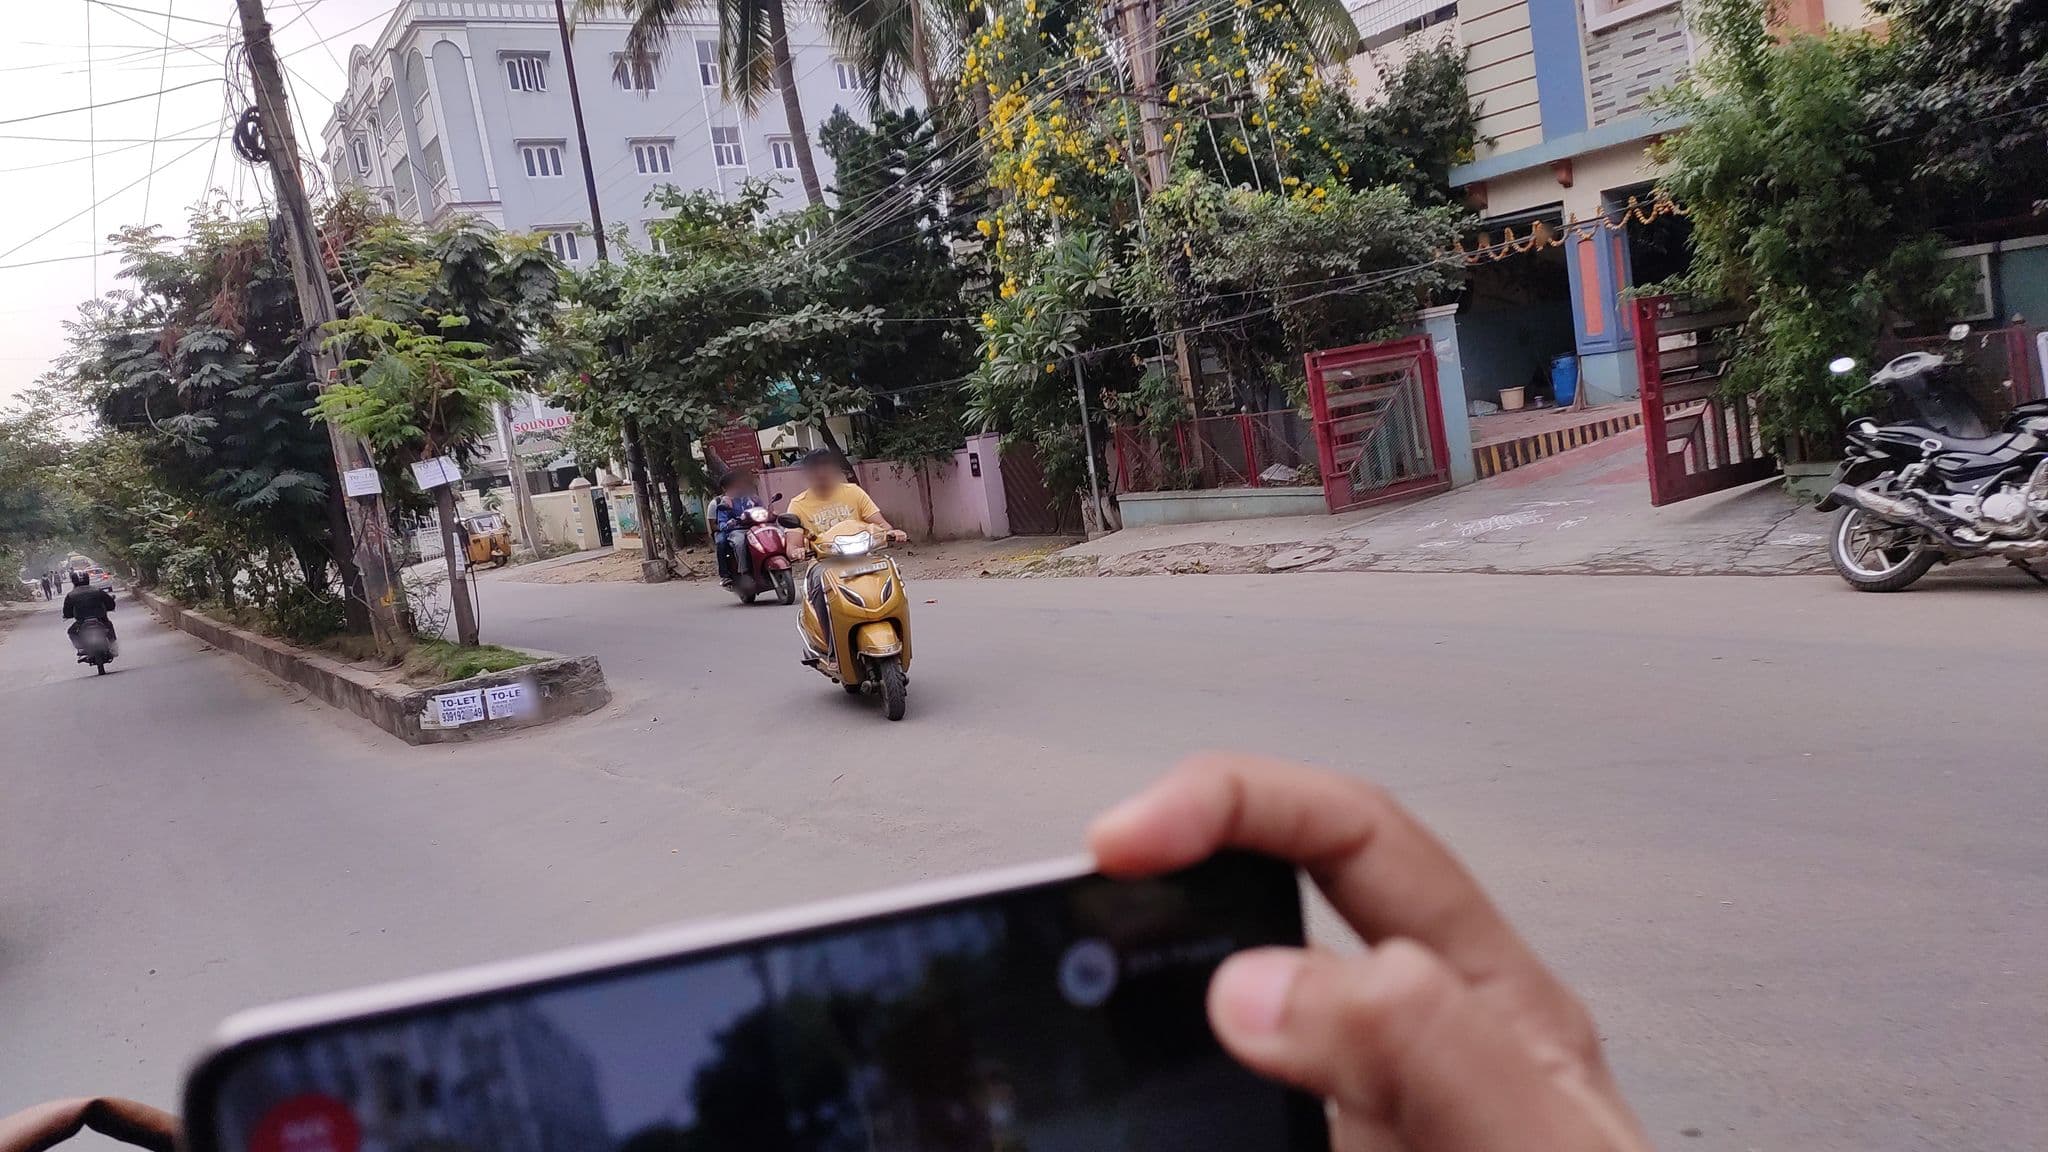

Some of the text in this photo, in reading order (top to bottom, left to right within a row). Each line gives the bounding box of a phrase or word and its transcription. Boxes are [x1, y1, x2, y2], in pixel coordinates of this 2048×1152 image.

[514, 418, 554, 432] SOUND
[441, 695, 477, 707] TO-LET
[491, 689, 520, 701] TO-LE
